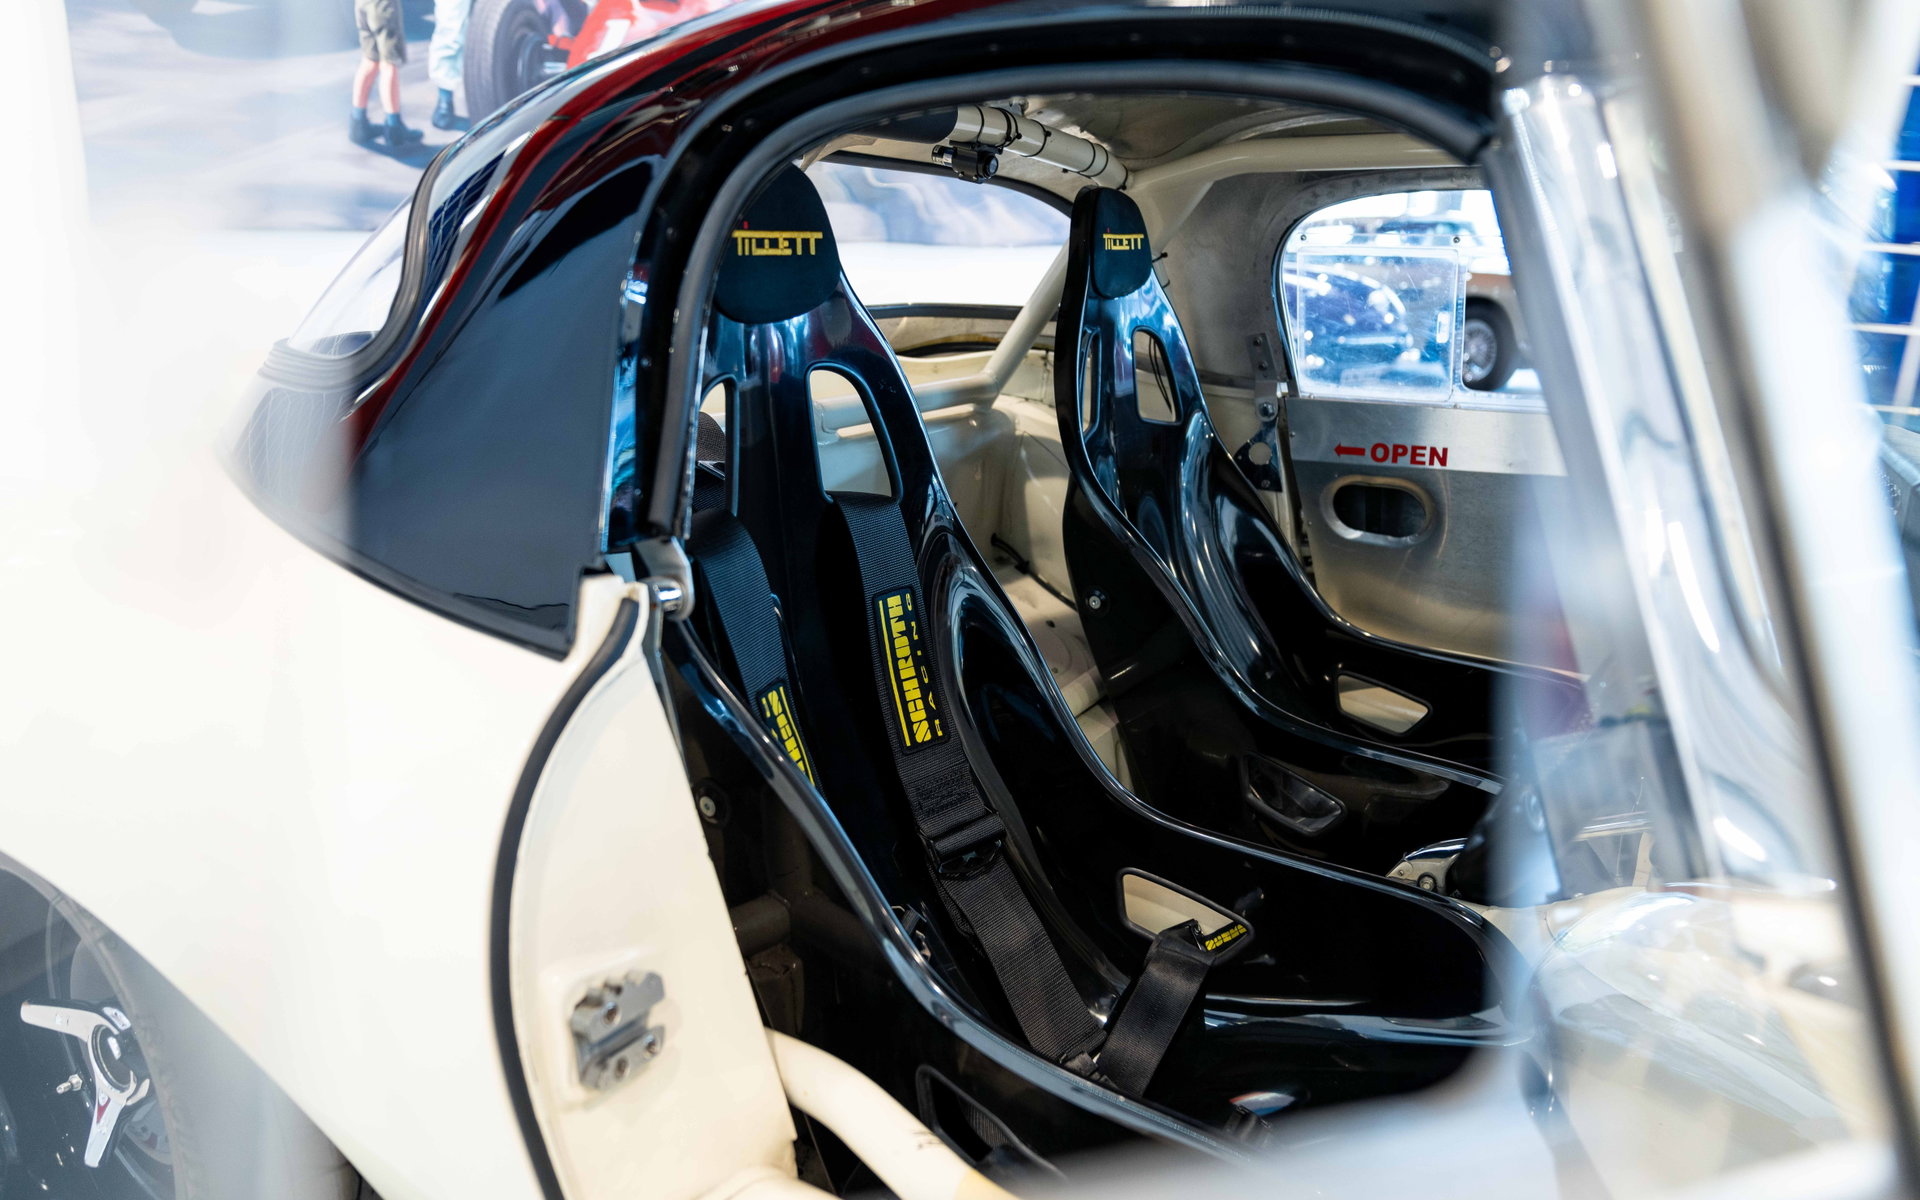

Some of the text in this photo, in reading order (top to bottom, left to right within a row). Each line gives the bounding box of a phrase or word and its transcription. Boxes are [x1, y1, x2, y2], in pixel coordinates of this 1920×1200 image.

[1370, 442, 1448, 467] OPEN
[886, 594, 932, 744] SCHROTH
[905, 593, 943, 737] RACING
